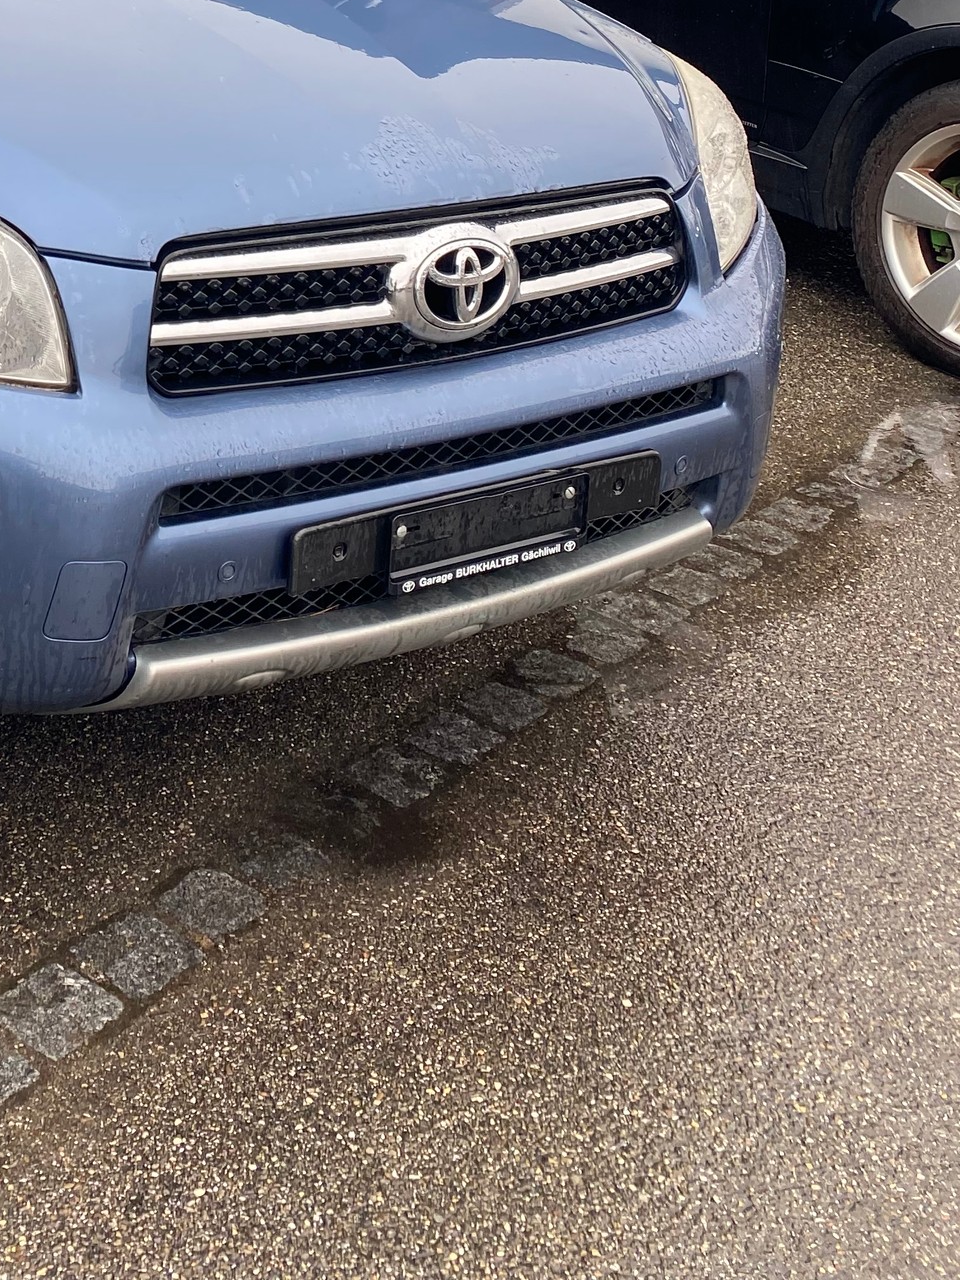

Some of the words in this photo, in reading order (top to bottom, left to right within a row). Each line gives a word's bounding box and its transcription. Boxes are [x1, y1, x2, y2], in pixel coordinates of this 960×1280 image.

[419, 573, 453, 587] Garage
[456, 555, 519, 578] BURKHALTER
[521, 544, 561, 562] Gächliwil
